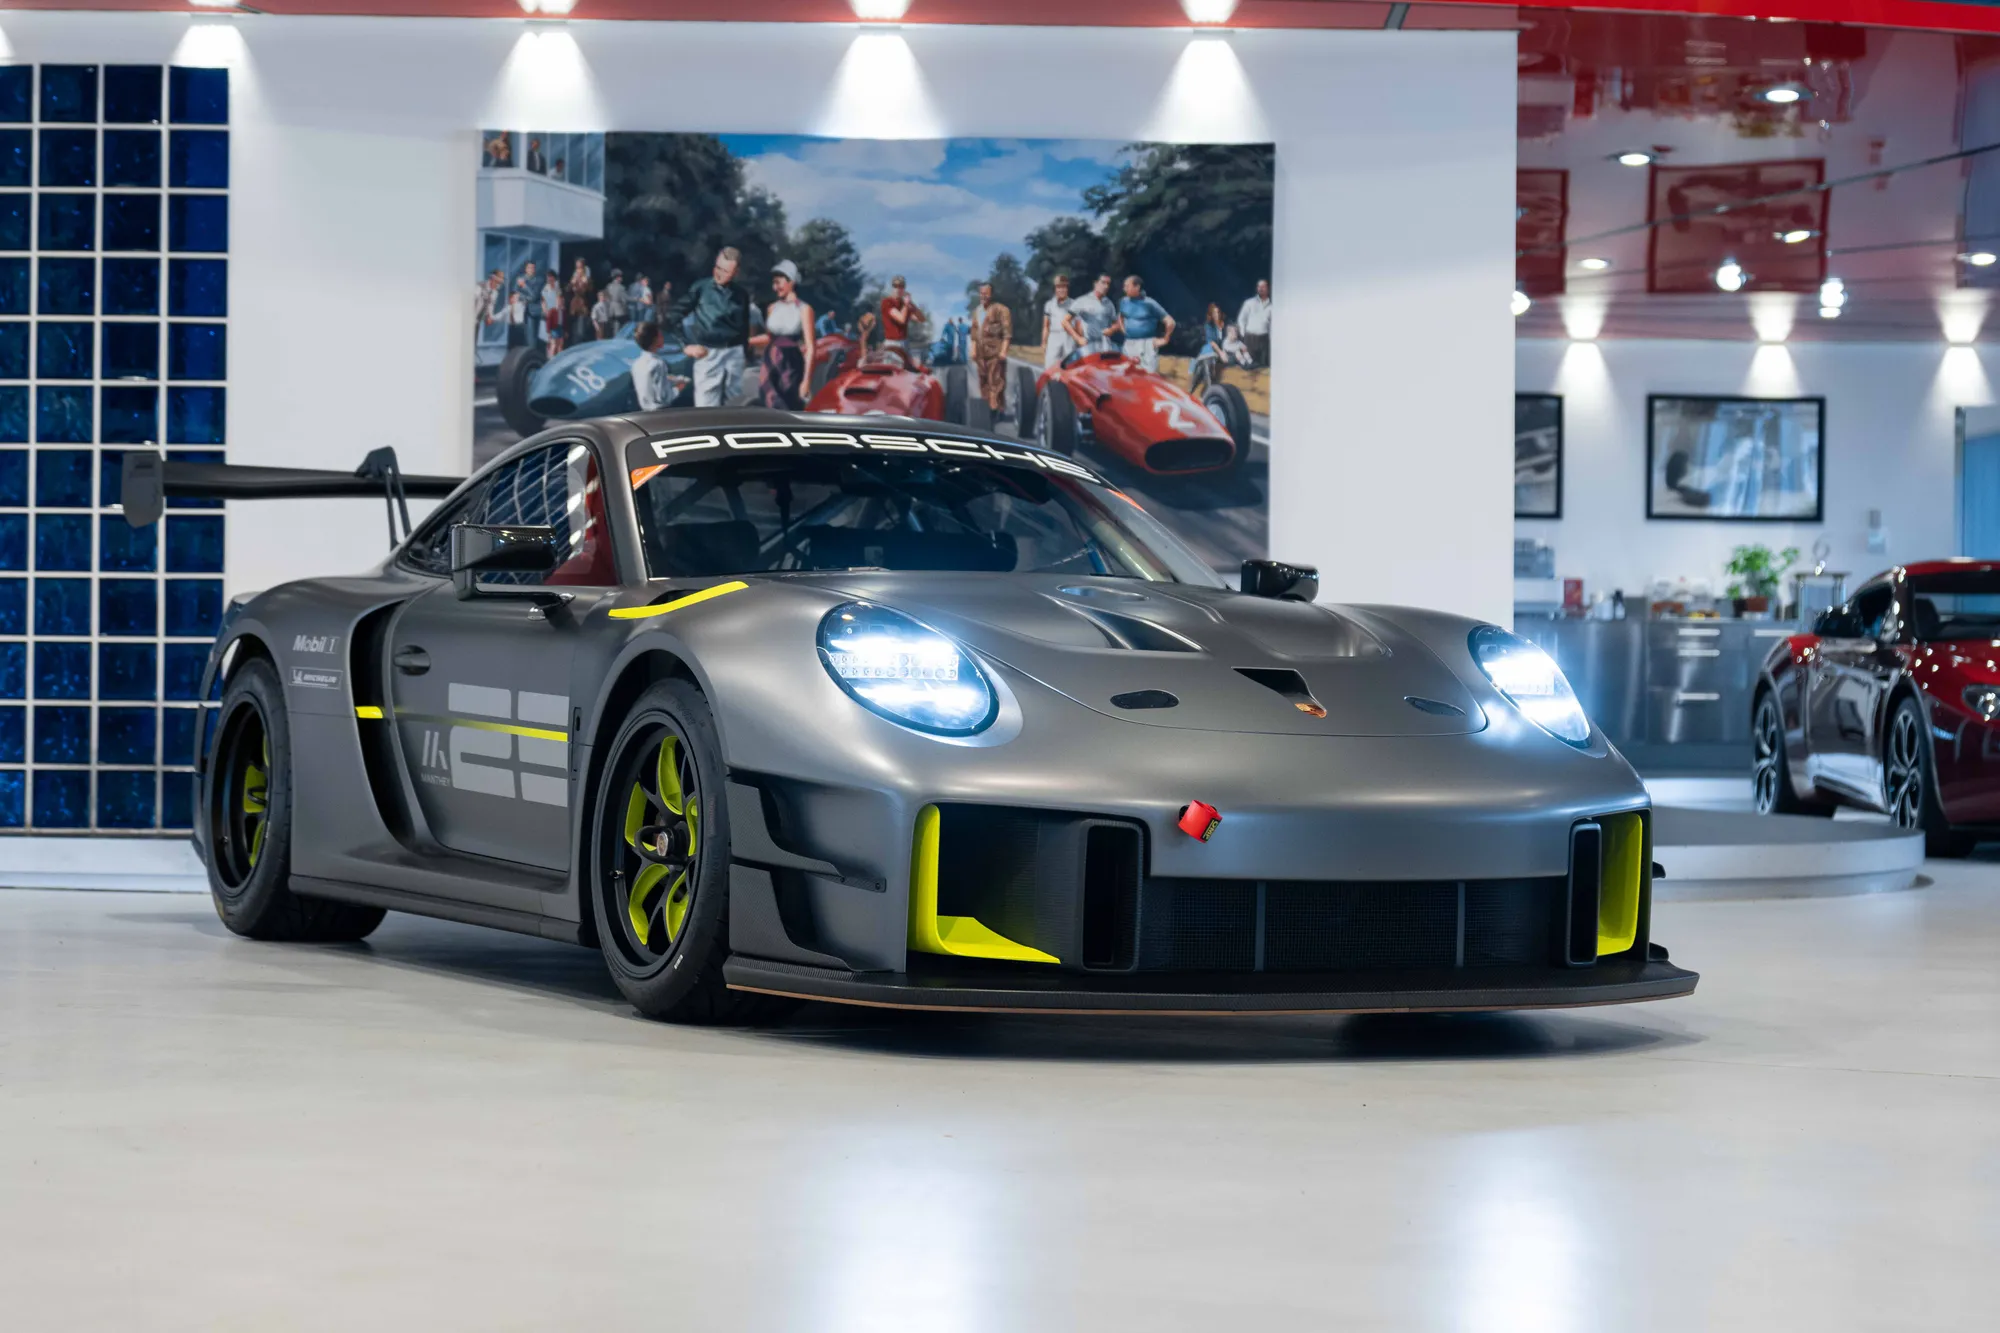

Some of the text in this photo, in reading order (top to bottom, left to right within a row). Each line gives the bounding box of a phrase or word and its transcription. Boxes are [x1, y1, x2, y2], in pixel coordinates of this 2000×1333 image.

[566, 365, 606, 393] 18
[1152, 399, 1197, 430] 2
[651, 431, 1102, 484] PORSCHE
[292, 634, 327, 653] Mobil
